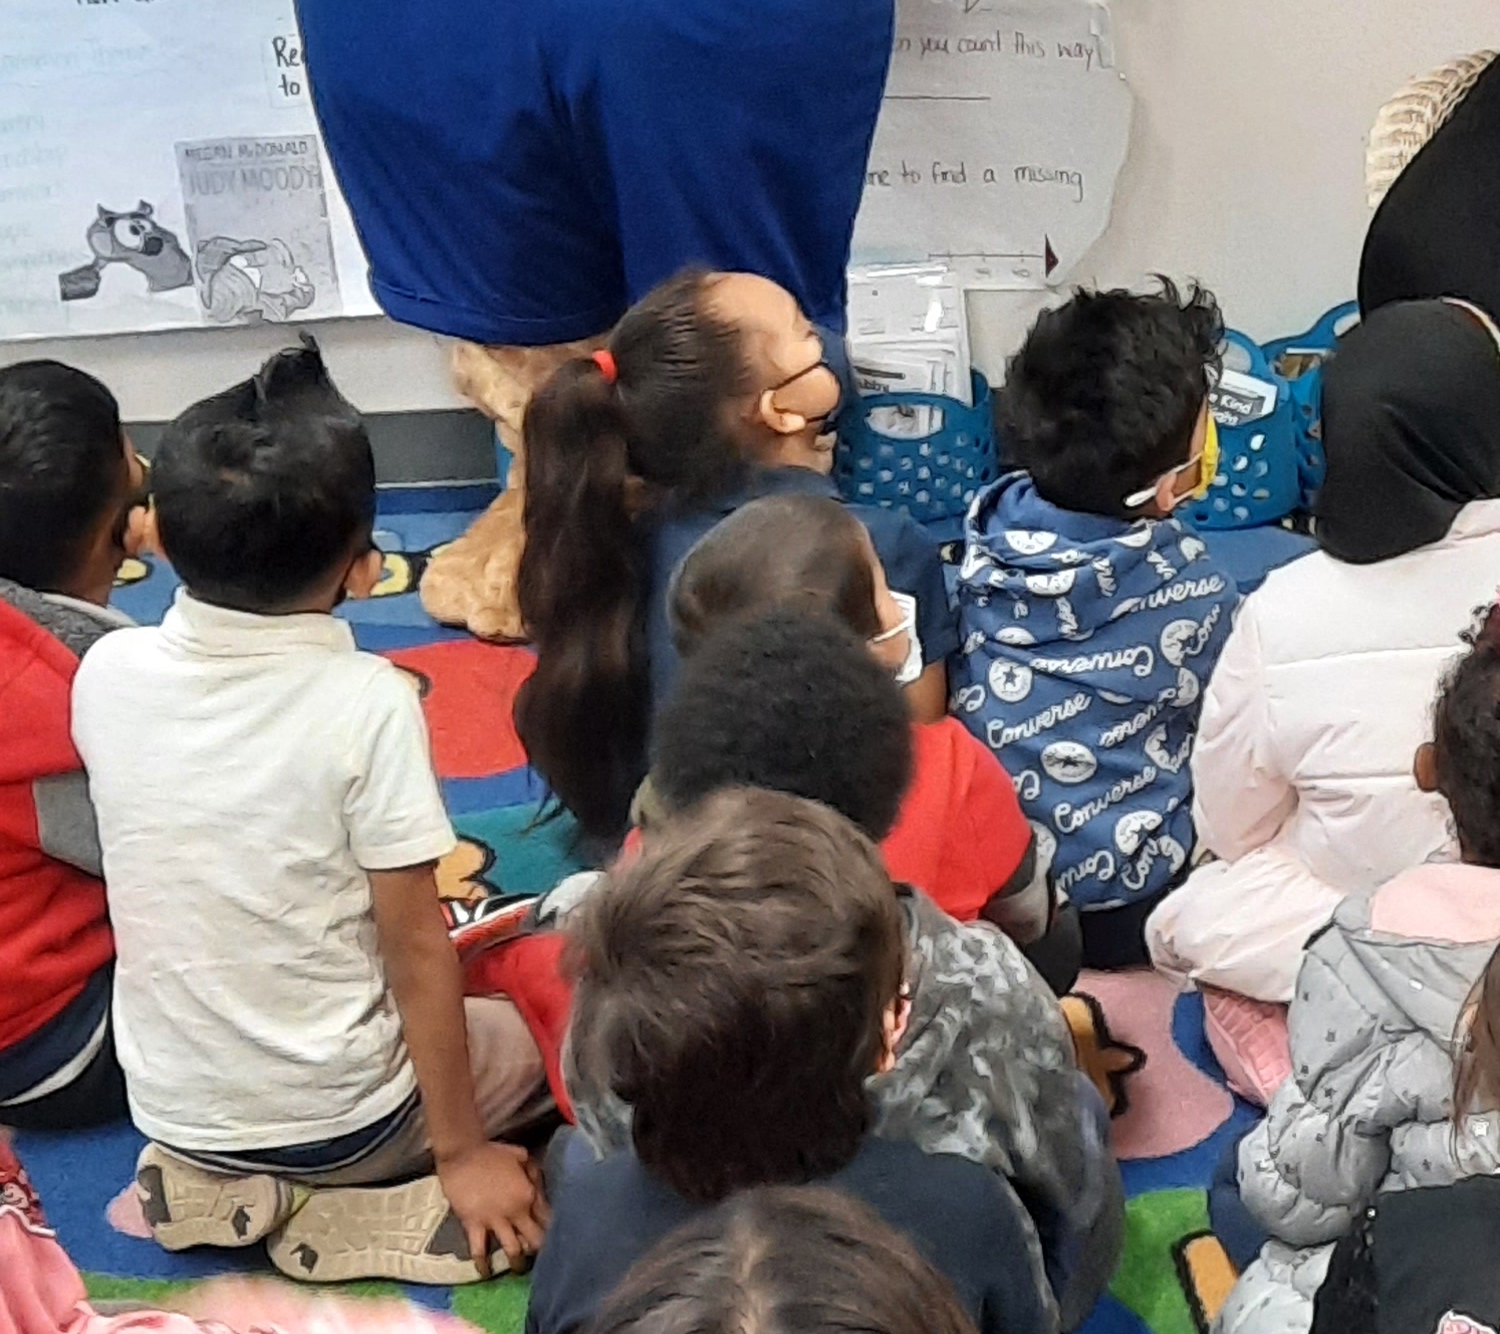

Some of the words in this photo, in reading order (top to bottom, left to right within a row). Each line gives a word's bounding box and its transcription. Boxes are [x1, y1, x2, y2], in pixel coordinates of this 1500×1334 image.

[982, 168, 997, 184] a
[1013, 164, 1085, 204] missing
[986, 690, 1093, 748] Converse
[1053, 765, 1157, 834] Converse
